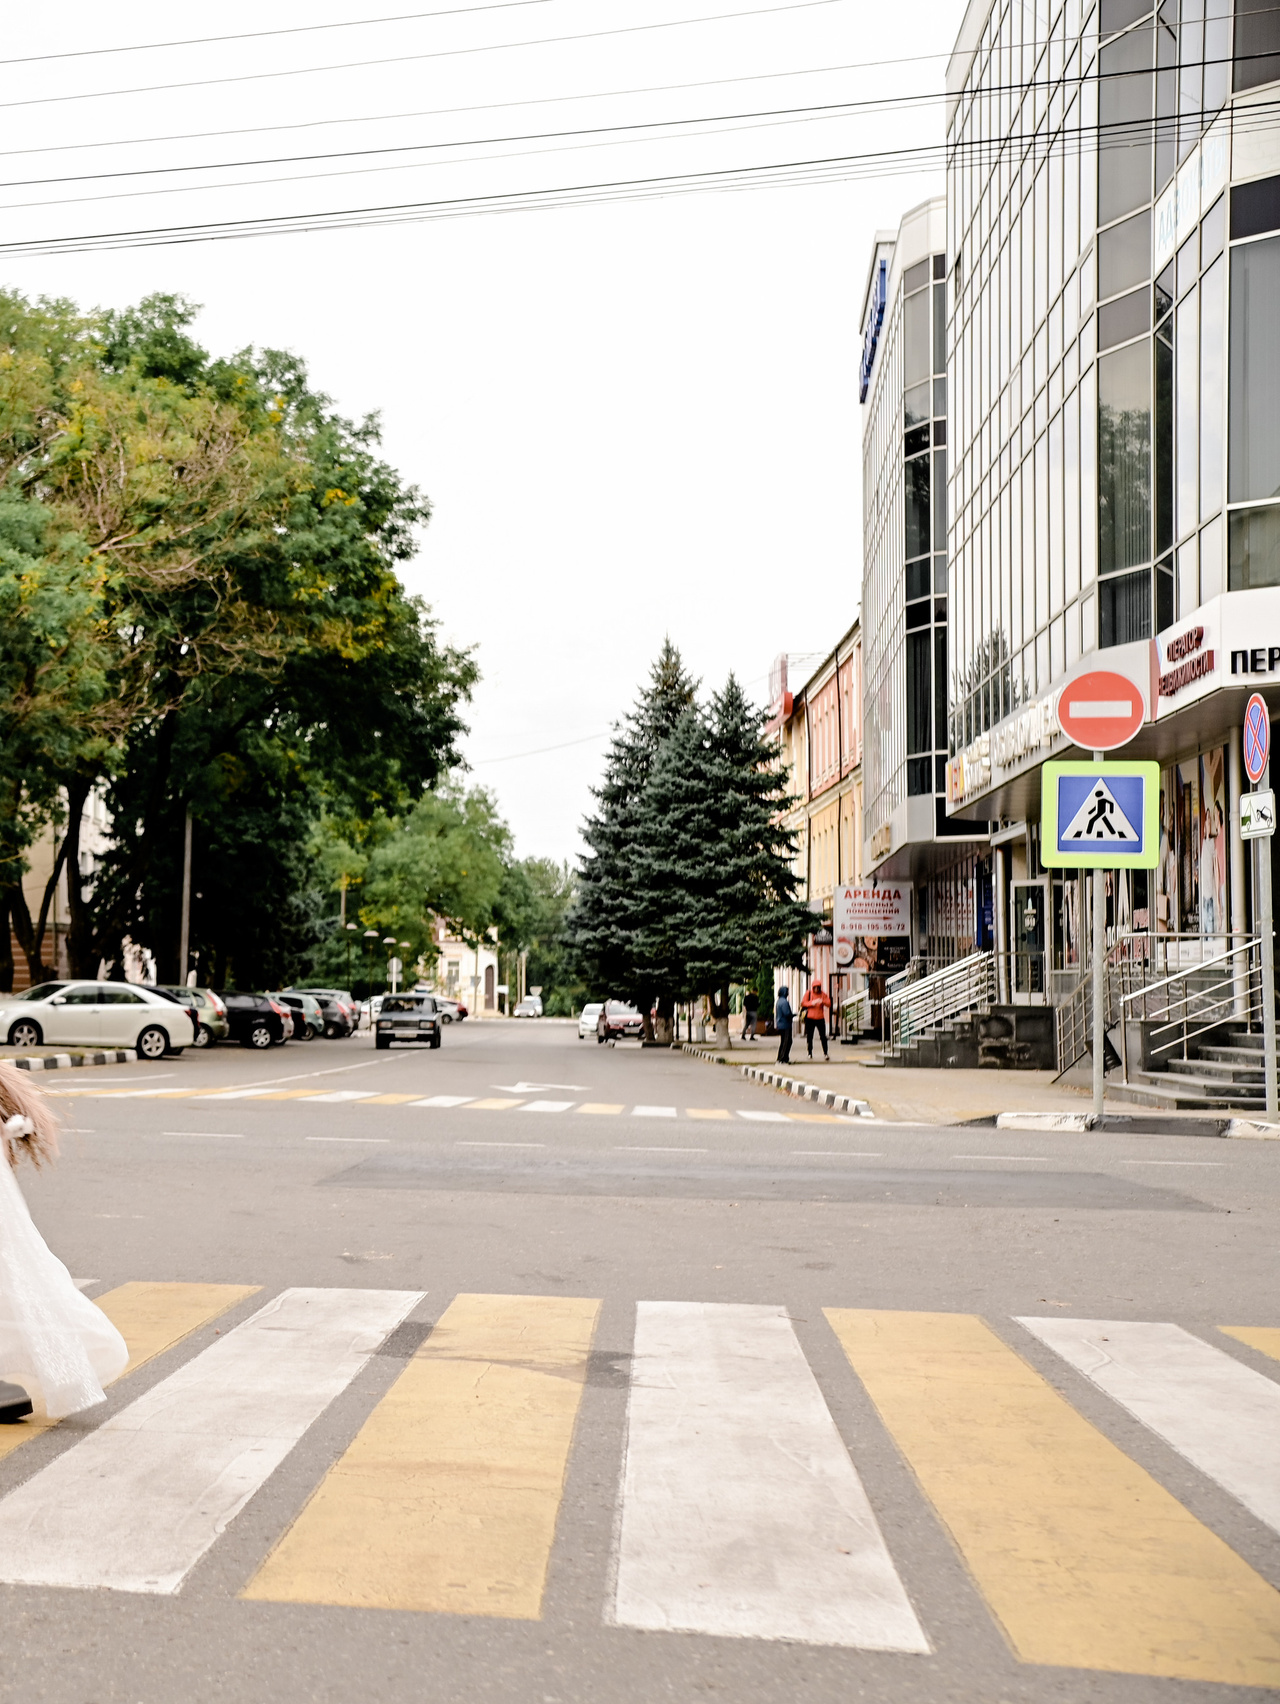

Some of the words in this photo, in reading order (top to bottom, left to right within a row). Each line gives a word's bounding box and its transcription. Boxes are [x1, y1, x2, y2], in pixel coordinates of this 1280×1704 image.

[1167, 626, 1204, 662] ОПЕРАТОР
[1159, 649, 1214, 696] НЕДВИЖИМОСТИ
[844, 889, 901, 901] АРЕНДА
